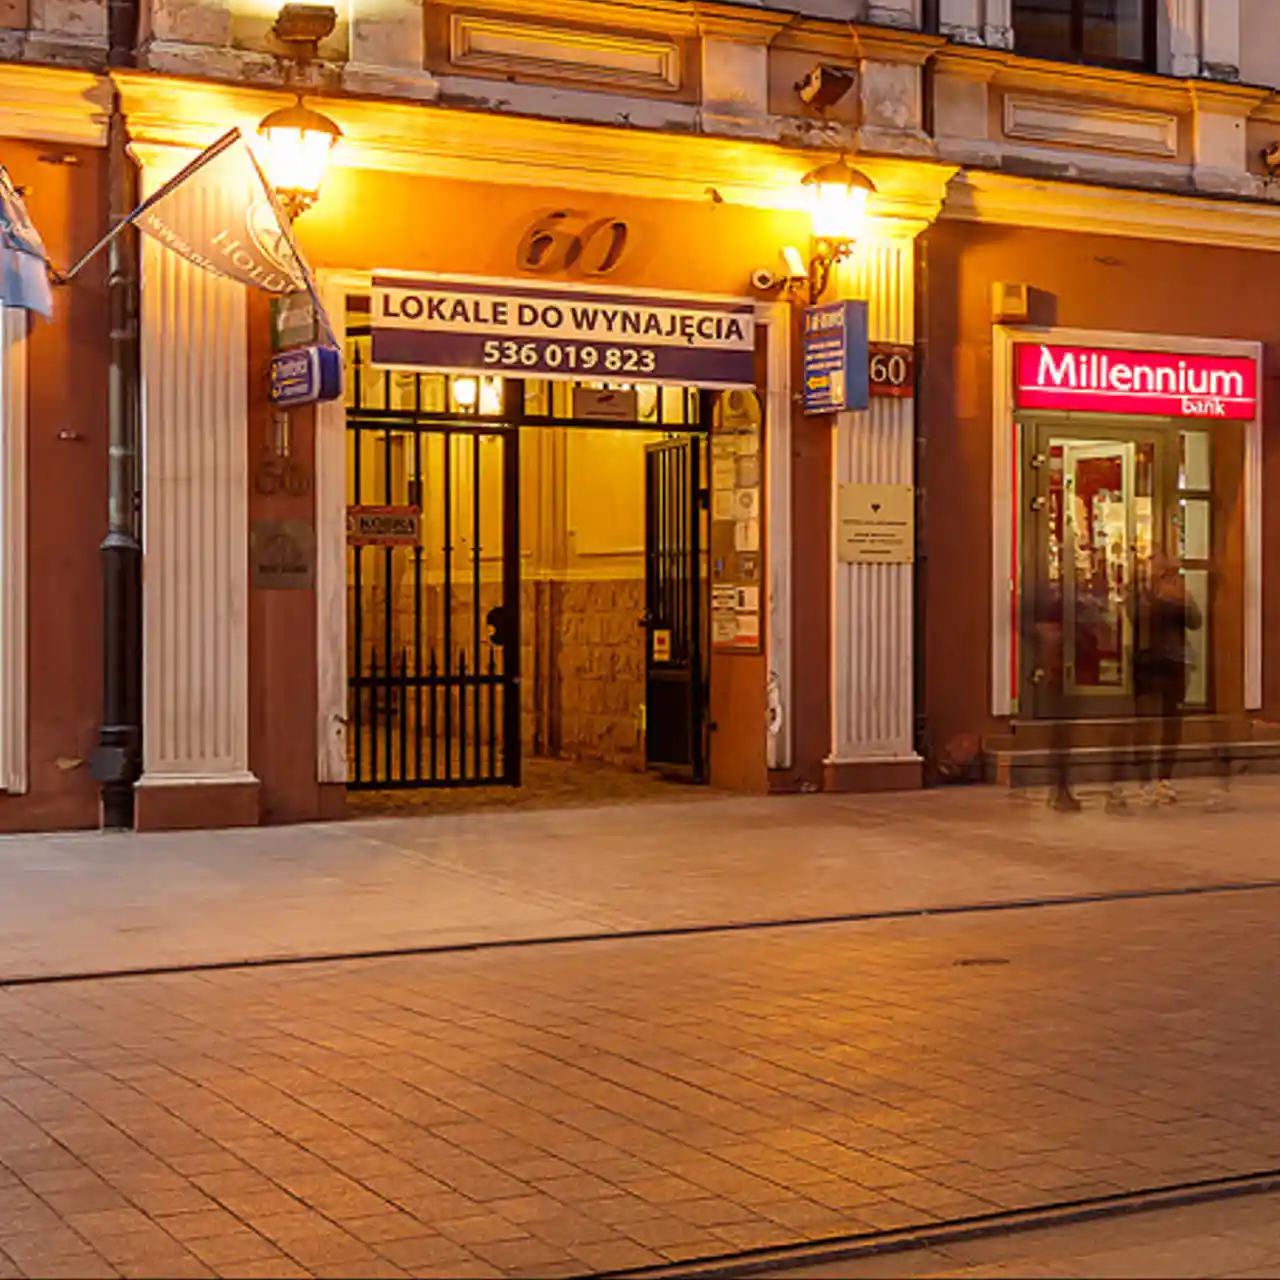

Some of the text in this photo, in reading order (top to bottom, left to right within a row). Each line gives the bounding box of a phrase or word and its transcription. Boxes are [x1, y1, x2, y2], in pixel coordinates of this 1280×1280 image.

[516, 209, 628, 277] 60
[381, 293, 745, 344] LOKALE DO WYNAJĘCIA
[483, 340, 656, 373] 536 019 823
[869, 354, 907, 385] 60
[1037, 345, 1243, 396] Millennium
[1181, 396, 1226, 417] bank
